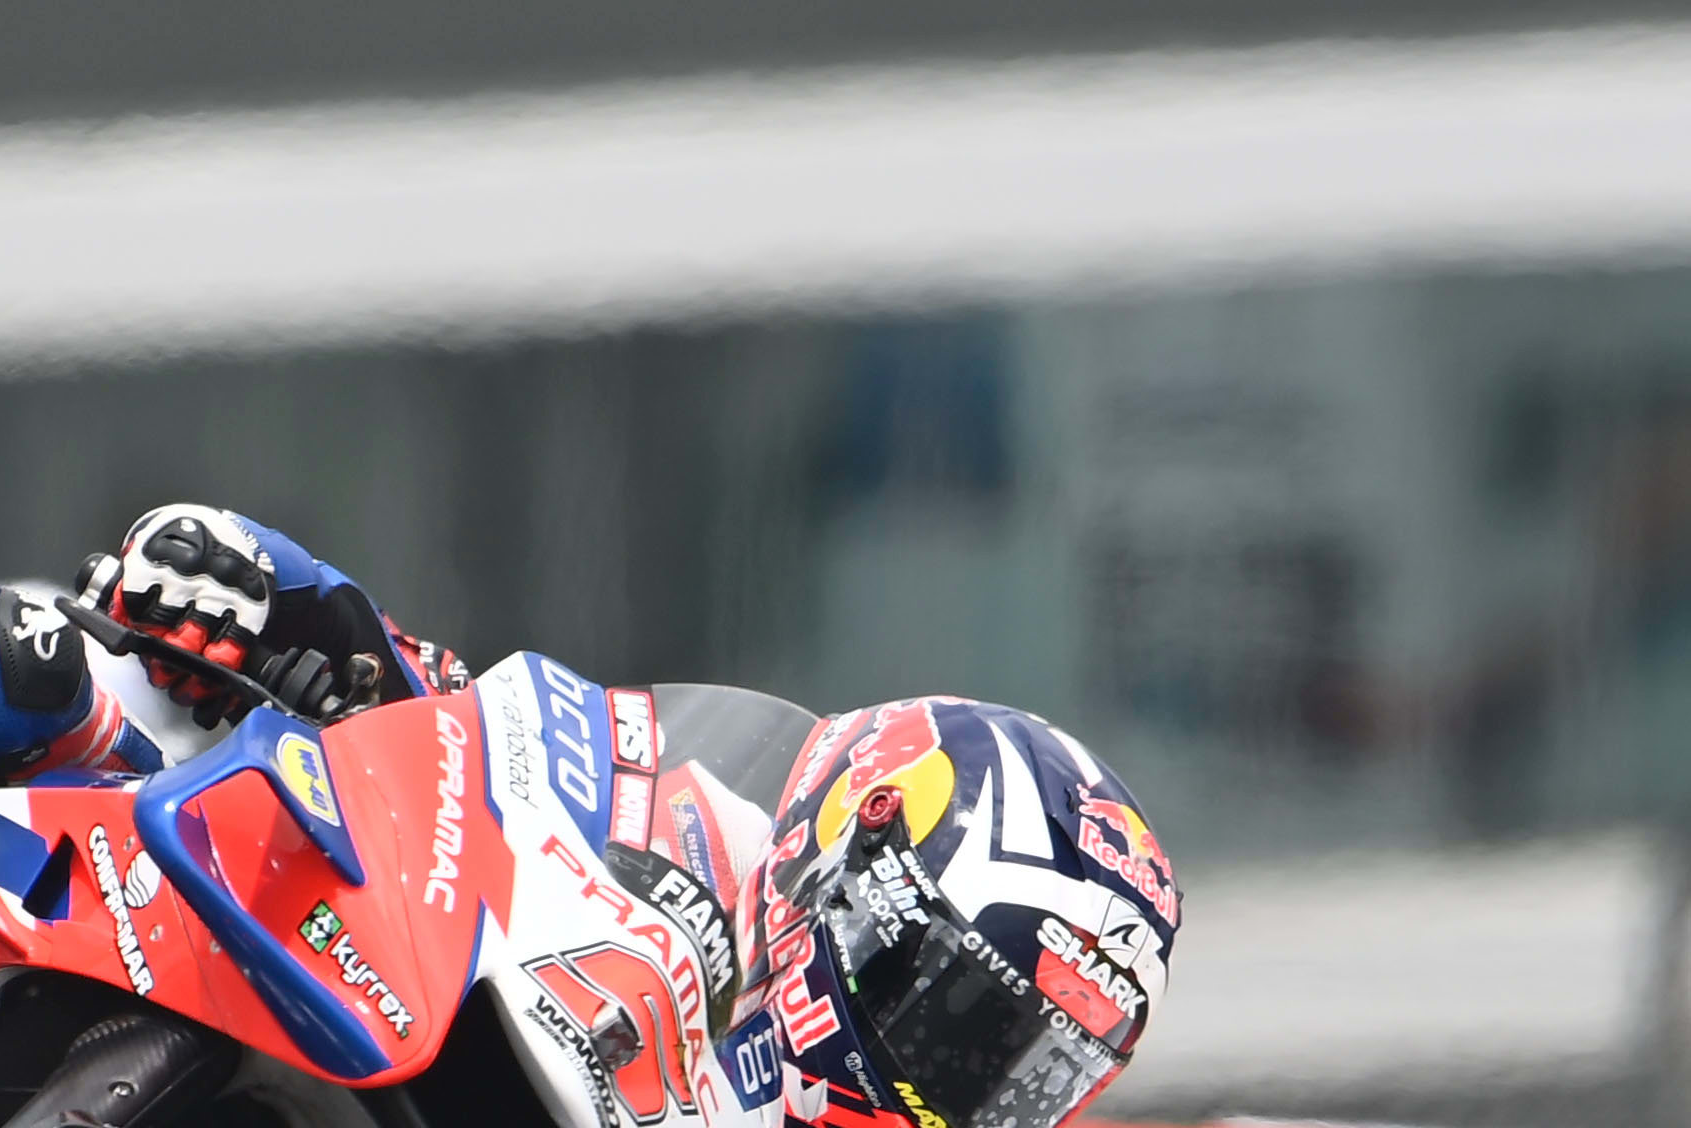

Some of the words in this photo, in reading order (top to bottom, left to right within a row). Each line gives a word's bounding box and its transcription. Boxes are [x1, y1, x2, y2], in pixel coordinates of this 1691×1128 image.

[422, 735, 465, 912] PRAMAC
[88, 825, 155, 997] CONFREMAR
[651, 868, 734, 996] FIAMM
[871, 845, 932, 925] Bihr
[330, 933, 415, 1034] kyrrex
[540, 834, 719, 1128] PRAMAC
[962, 931, 1030, 996] GIVES
[1038, 997, 1083, 1040] YOU
[1036, 917, 1146, 1020] SHARK
